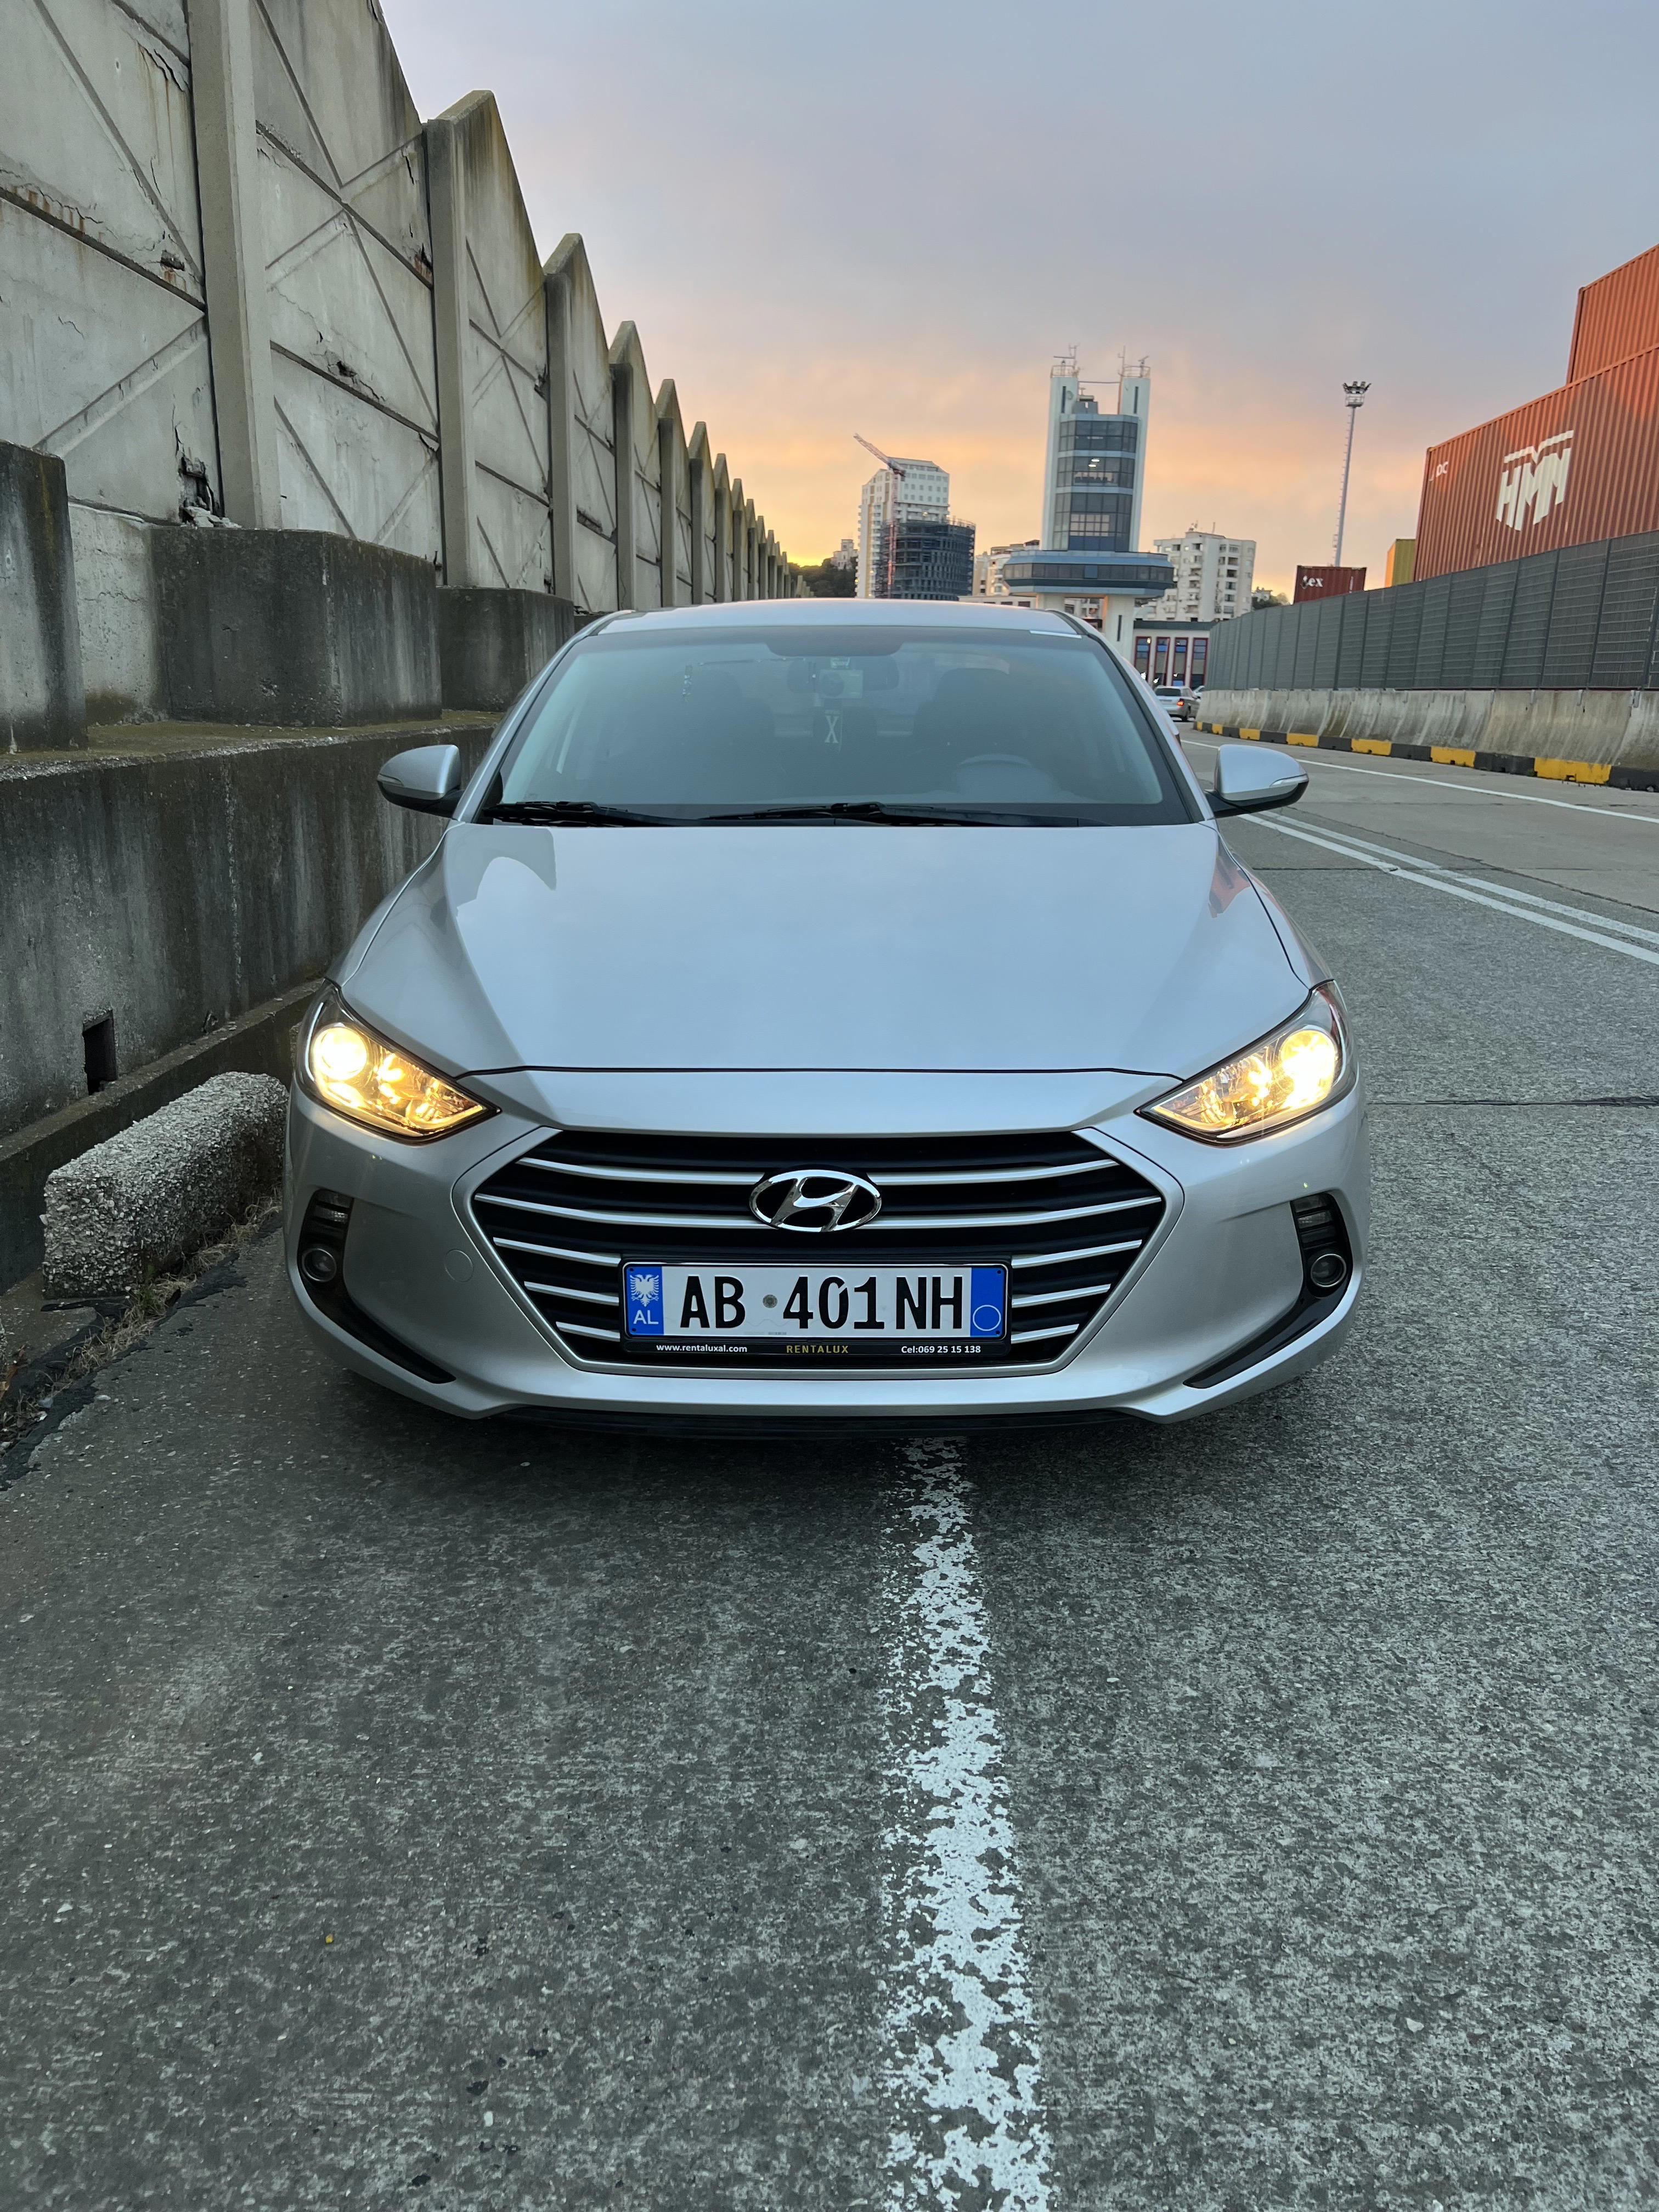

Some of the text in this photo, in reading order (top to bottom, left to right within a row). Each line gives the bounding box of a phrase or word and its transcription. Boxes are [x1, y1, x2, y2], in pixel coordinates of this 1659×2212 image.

[1496, 430, 1575, 532] HMM
[680, 1275, 963, 1329] AB 401 NH
[633, 1310, 659, 1324] AL
[656, 1344, 747, 1353] www.rentaluxal.com
[787, 1345, 849, 1353] RENTALUX
[901, 1345, 935, 1354] Cel:069
